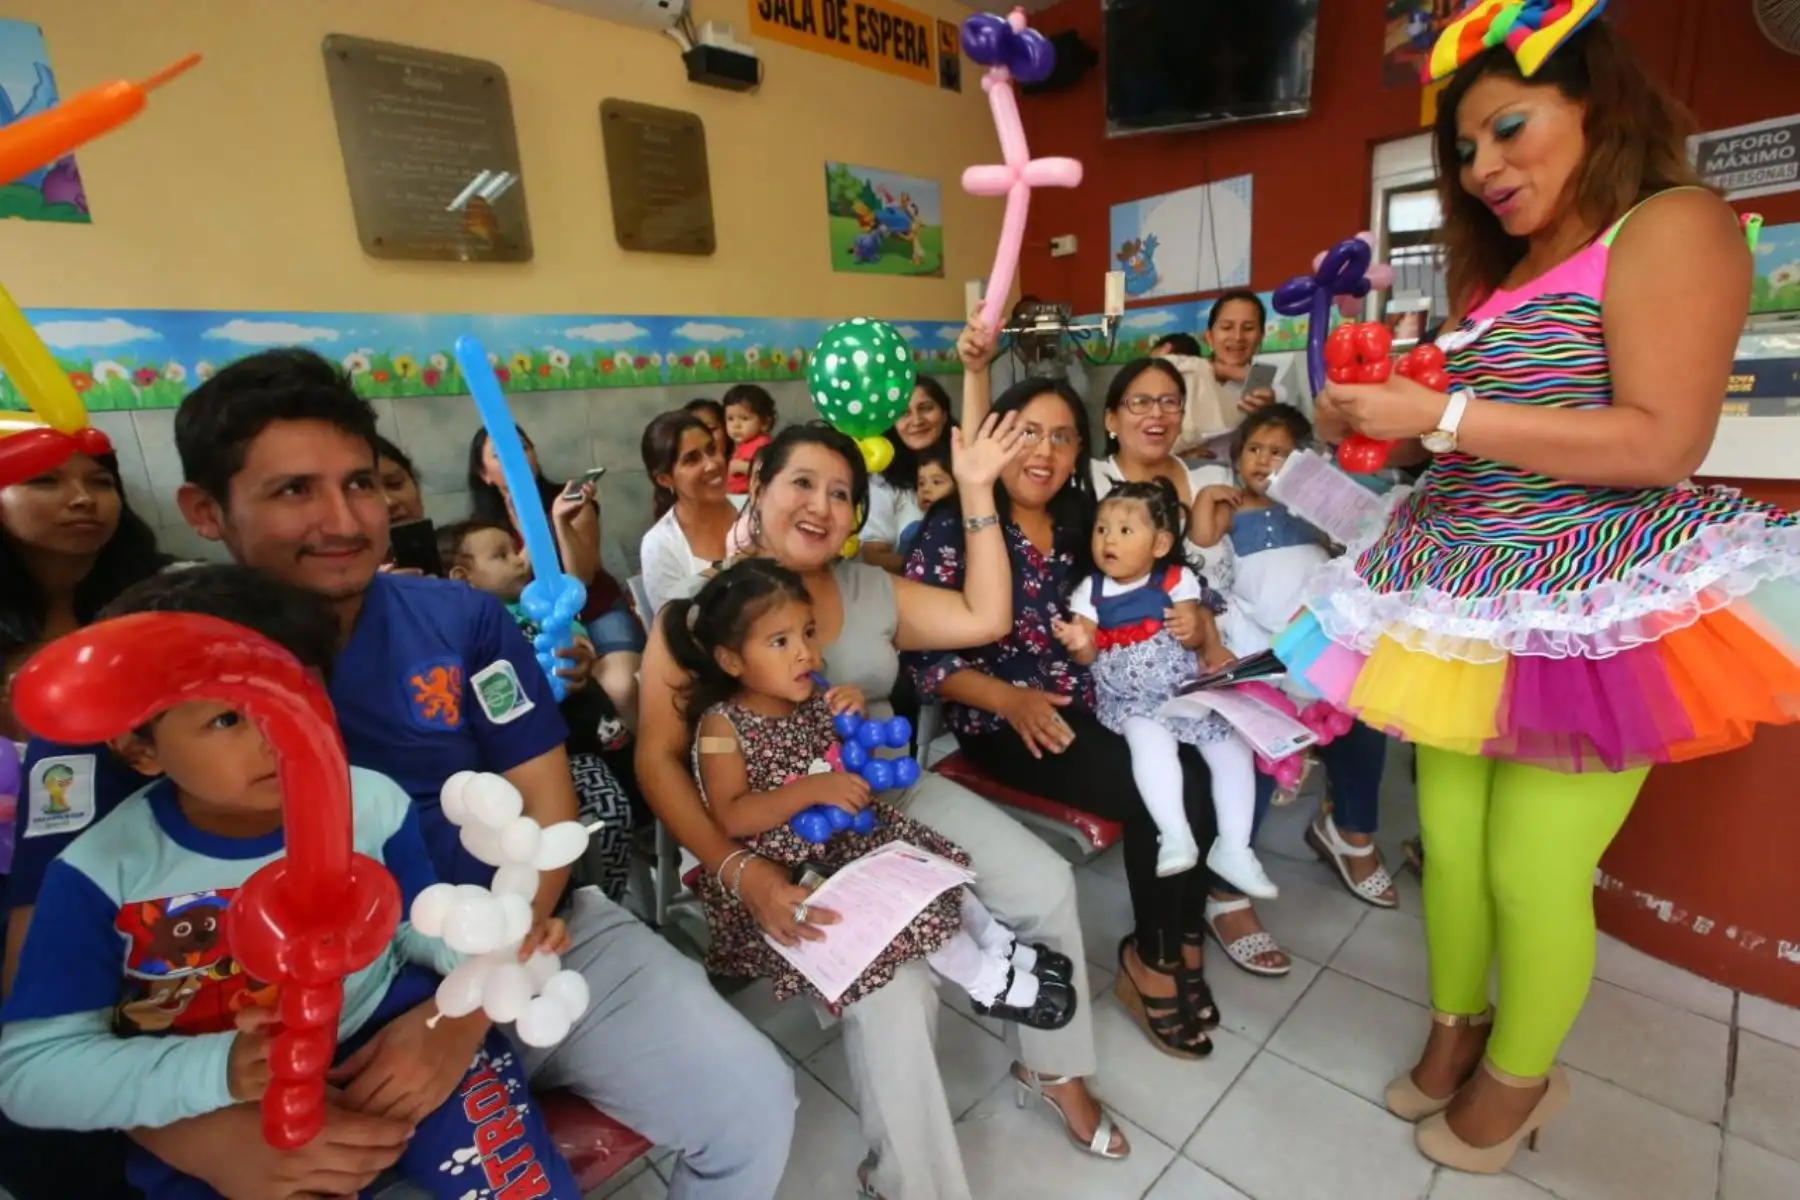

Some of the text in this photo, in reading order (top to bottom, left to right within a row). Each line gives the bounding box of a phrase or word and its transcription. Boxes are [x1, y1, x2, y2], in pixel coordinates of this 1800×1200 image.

[822, 0, 851, 45] DE
[854, 3, 930, 69] ESPERA
[1713, 130, 1791, 156] AFORO
